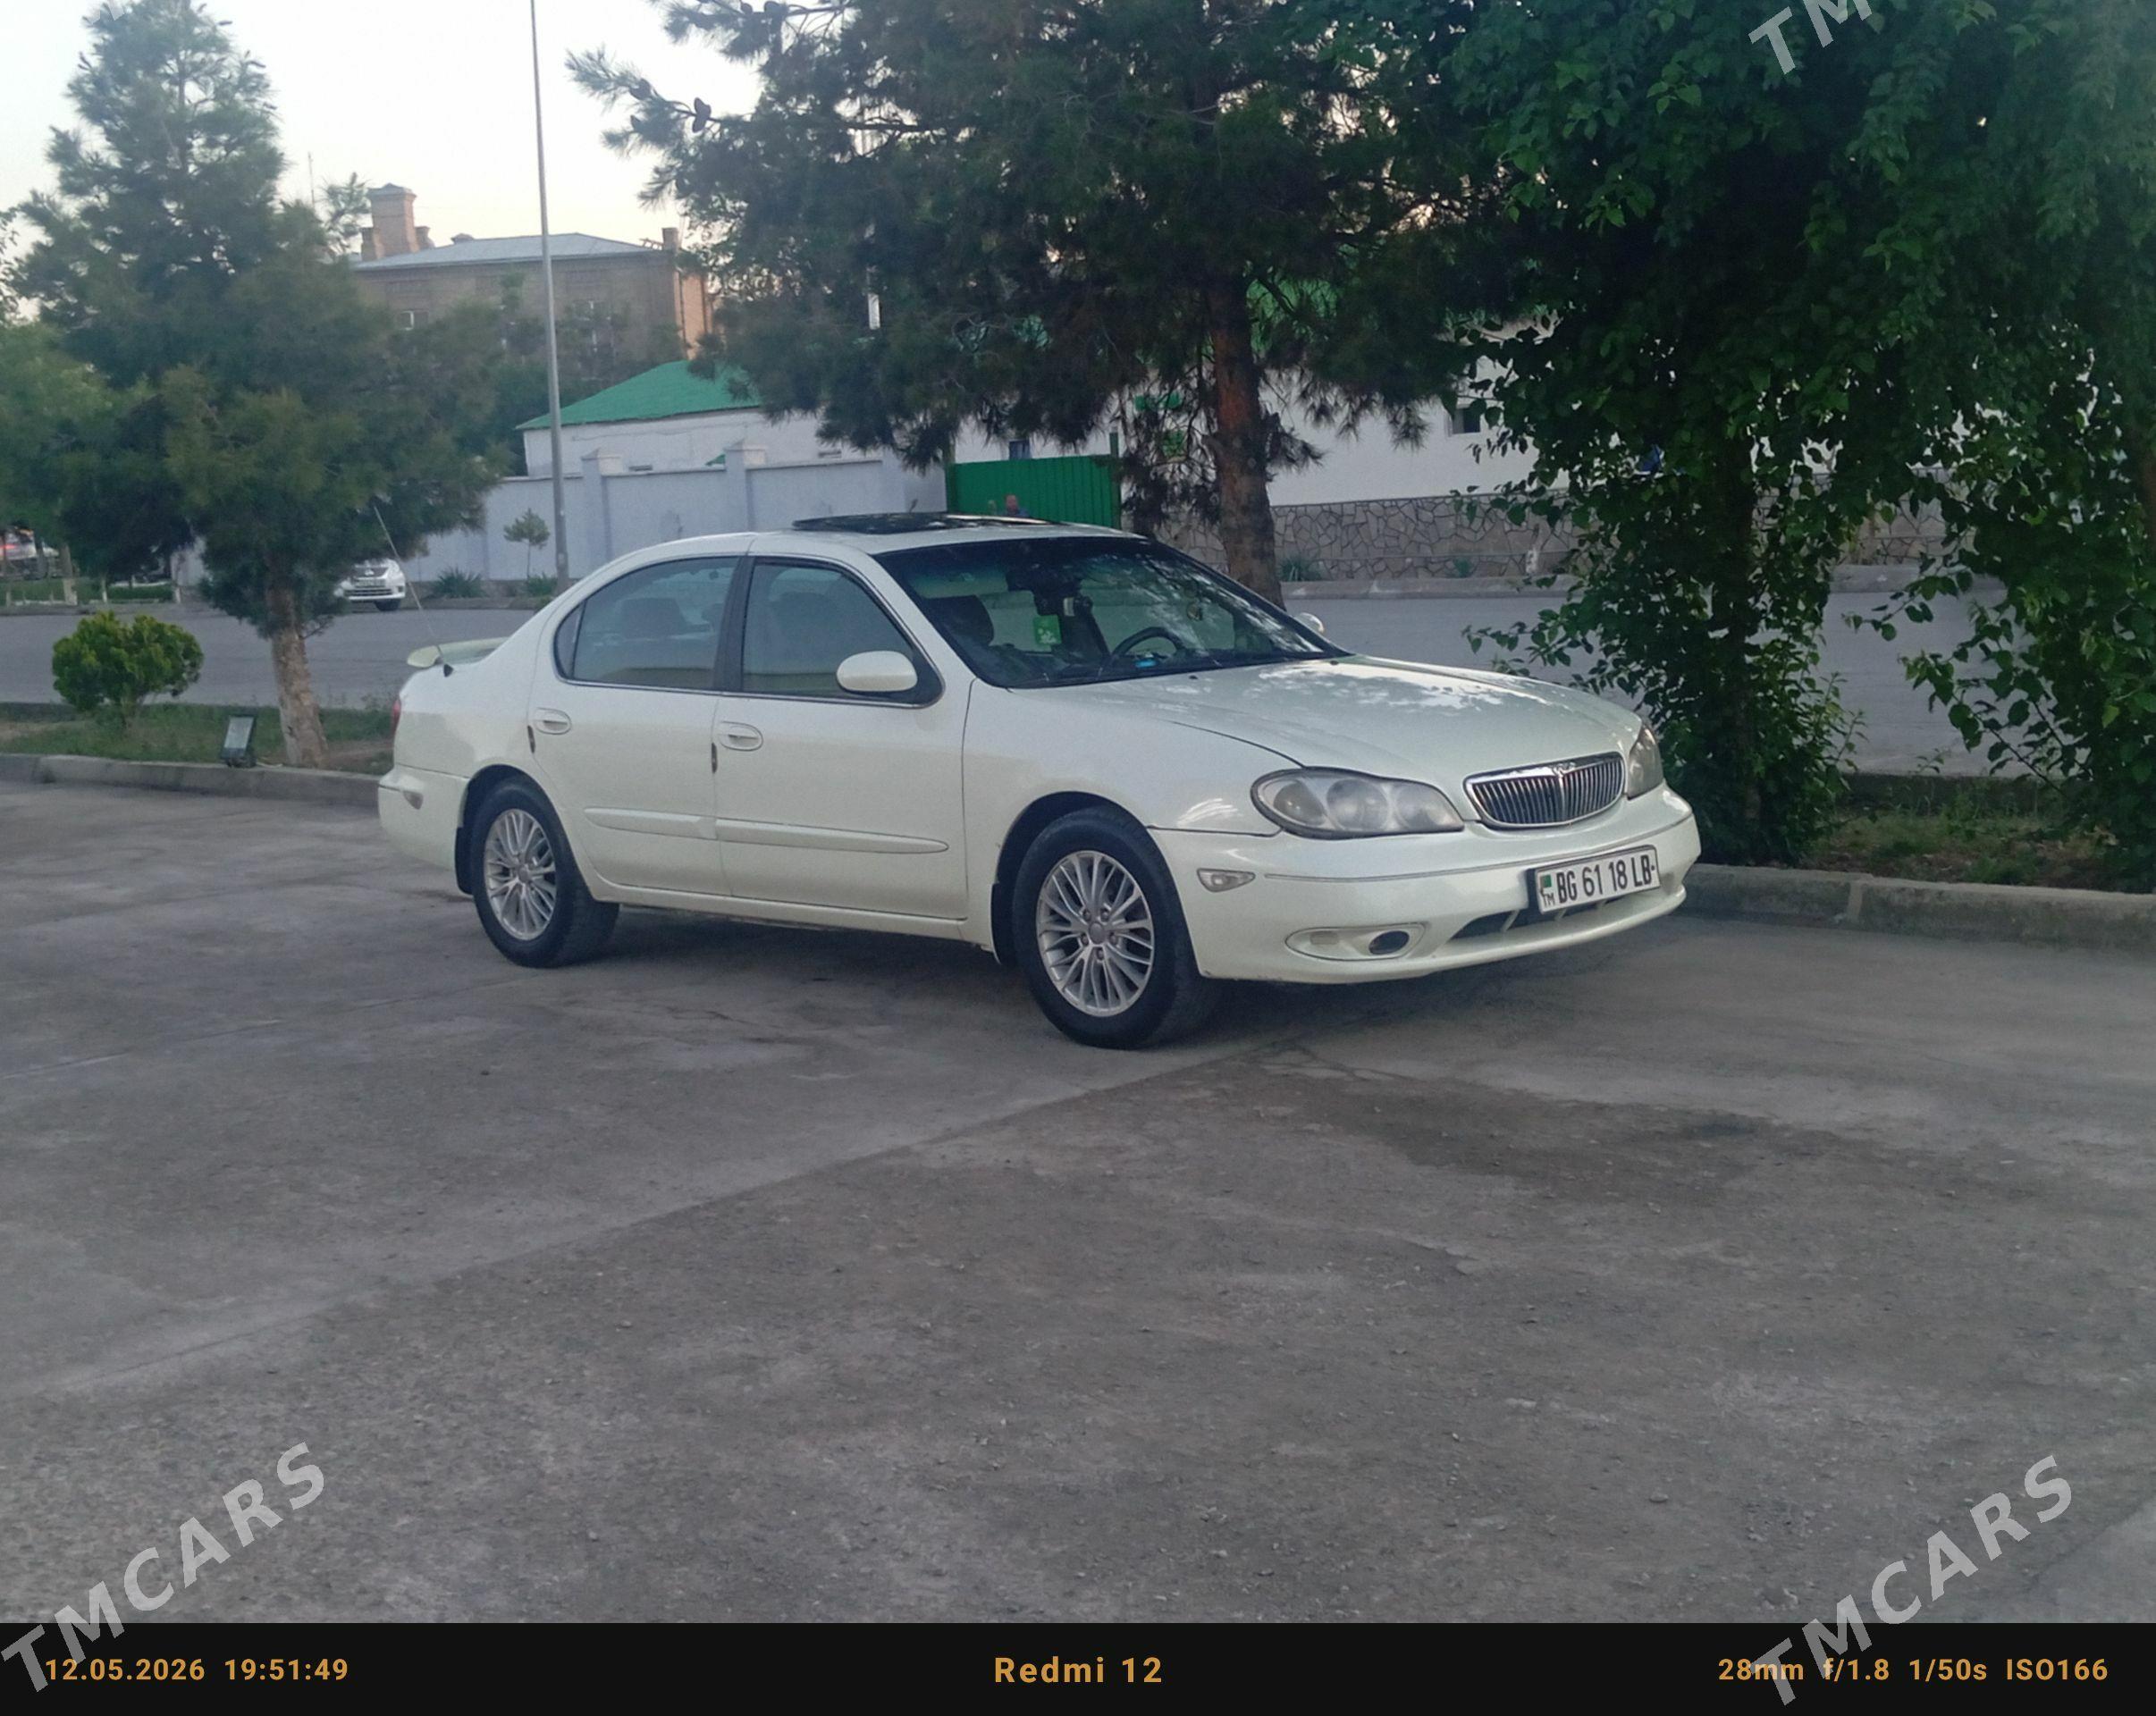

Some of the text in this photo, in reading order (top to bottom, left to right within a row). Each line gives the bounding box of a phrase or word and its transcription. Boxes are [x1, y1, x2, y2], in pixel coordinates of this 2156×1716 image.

[1556, 854, 1652, 904] BG 61 18 LB
[1542, 893, 1555, 907] TM
